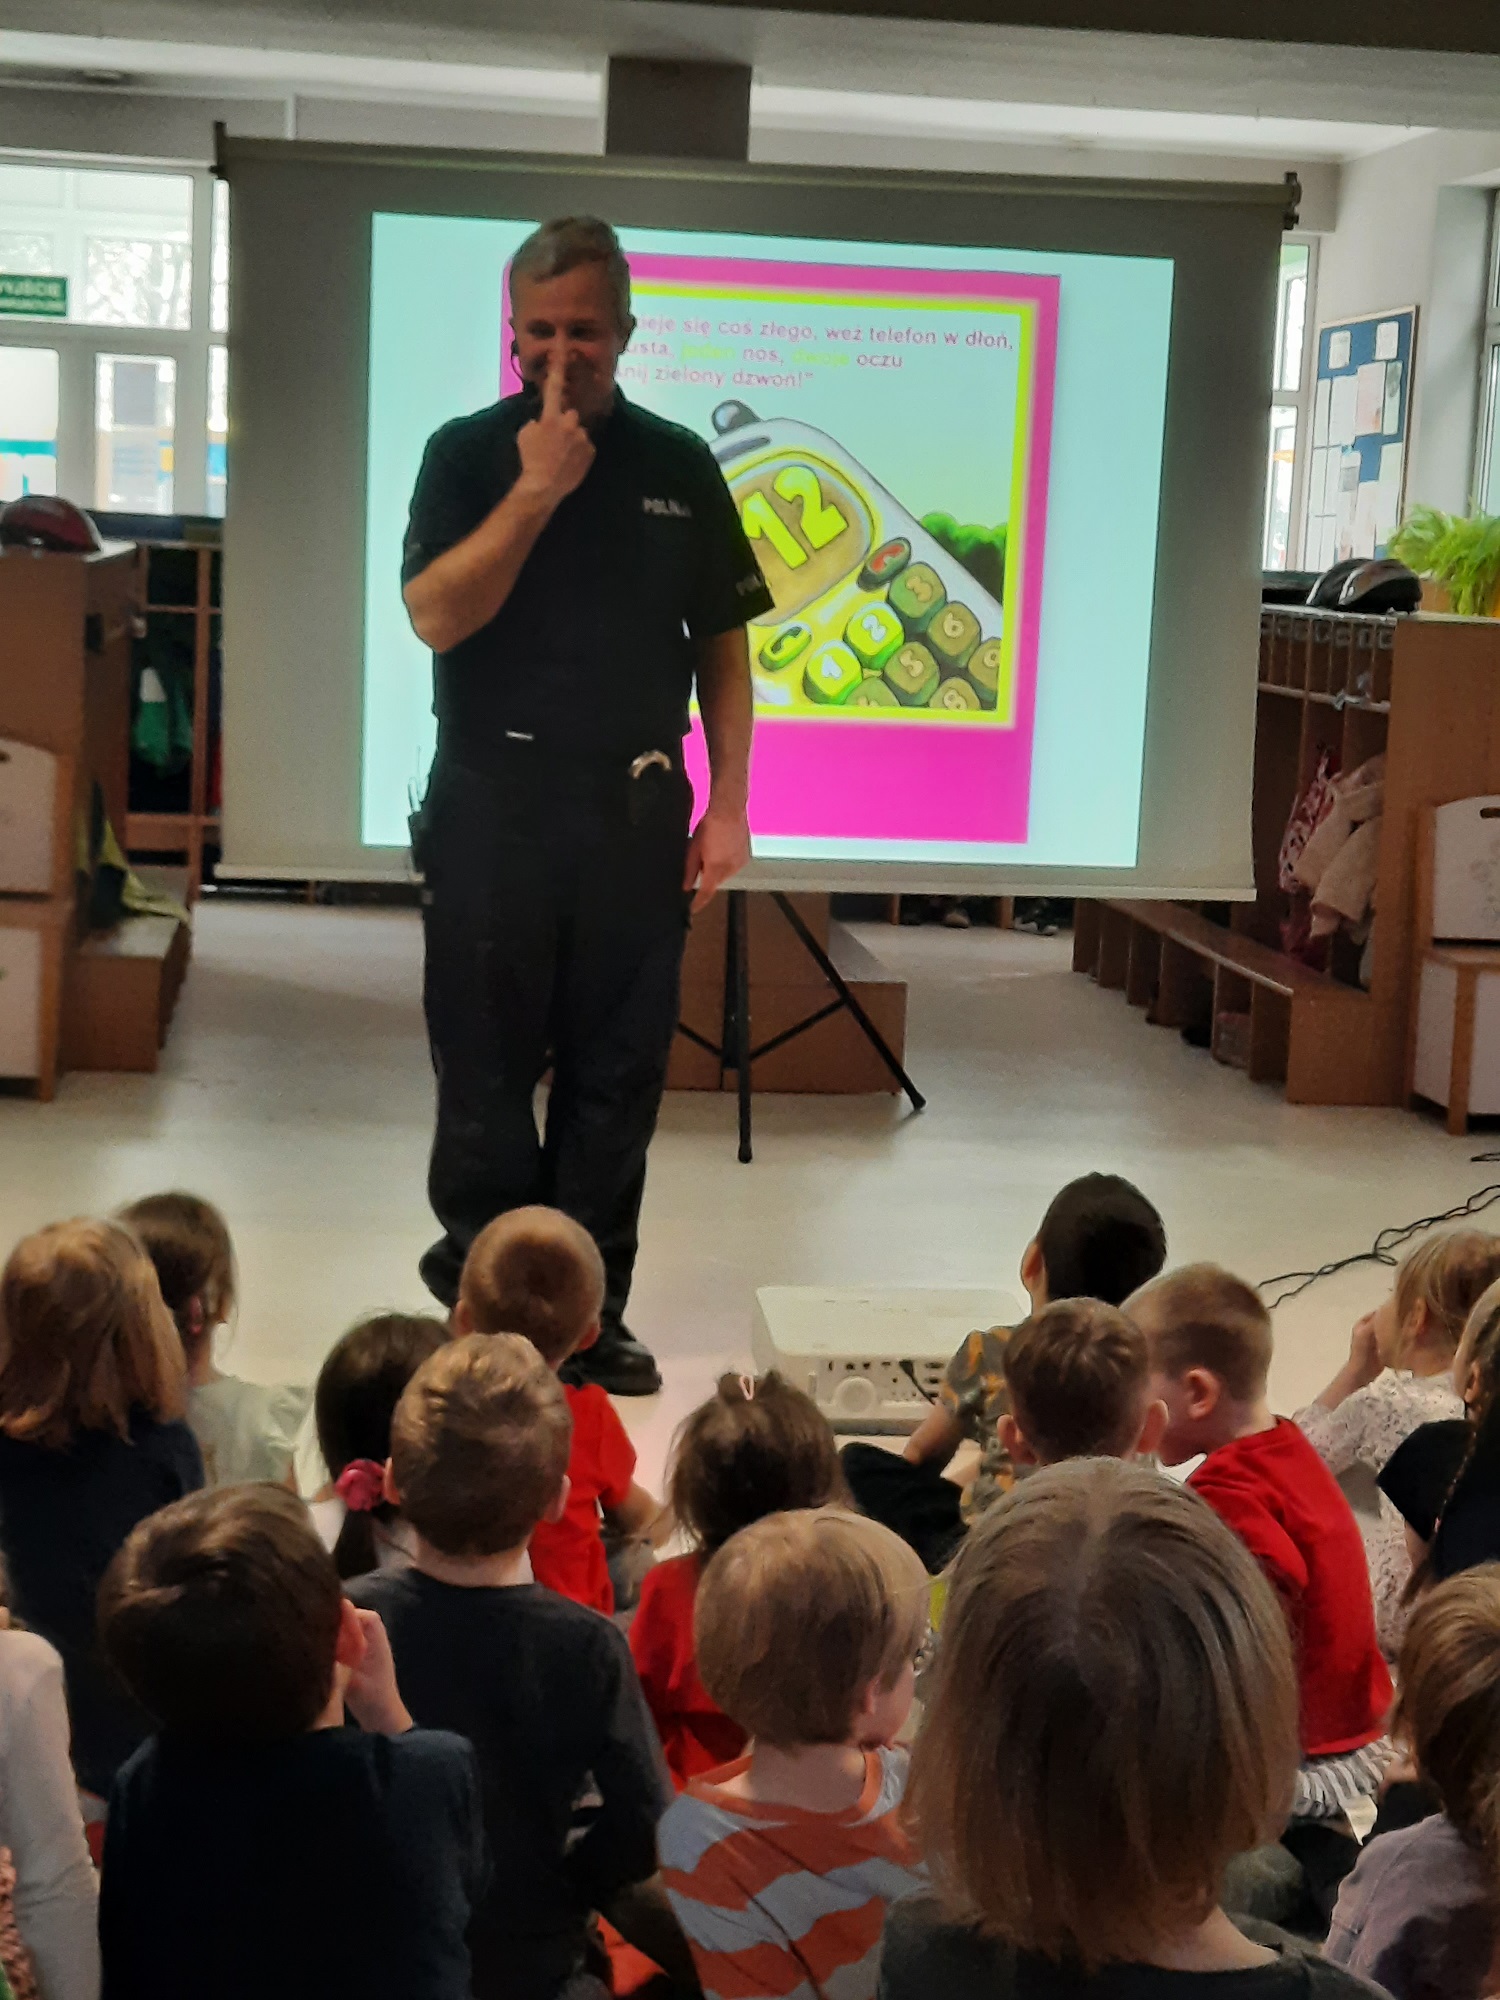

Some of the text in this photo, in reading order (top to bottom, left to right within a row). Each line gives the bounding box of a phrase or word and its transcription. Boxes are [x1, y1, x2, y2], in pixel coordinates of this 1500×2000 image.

[869, 326, 937, 344] telefon
[943, 331, 959, 345] w
[743, 348, 785, 366] nos,
[856, 353, 903, 368] oczu
[655, 363, 725, 388] zielony
